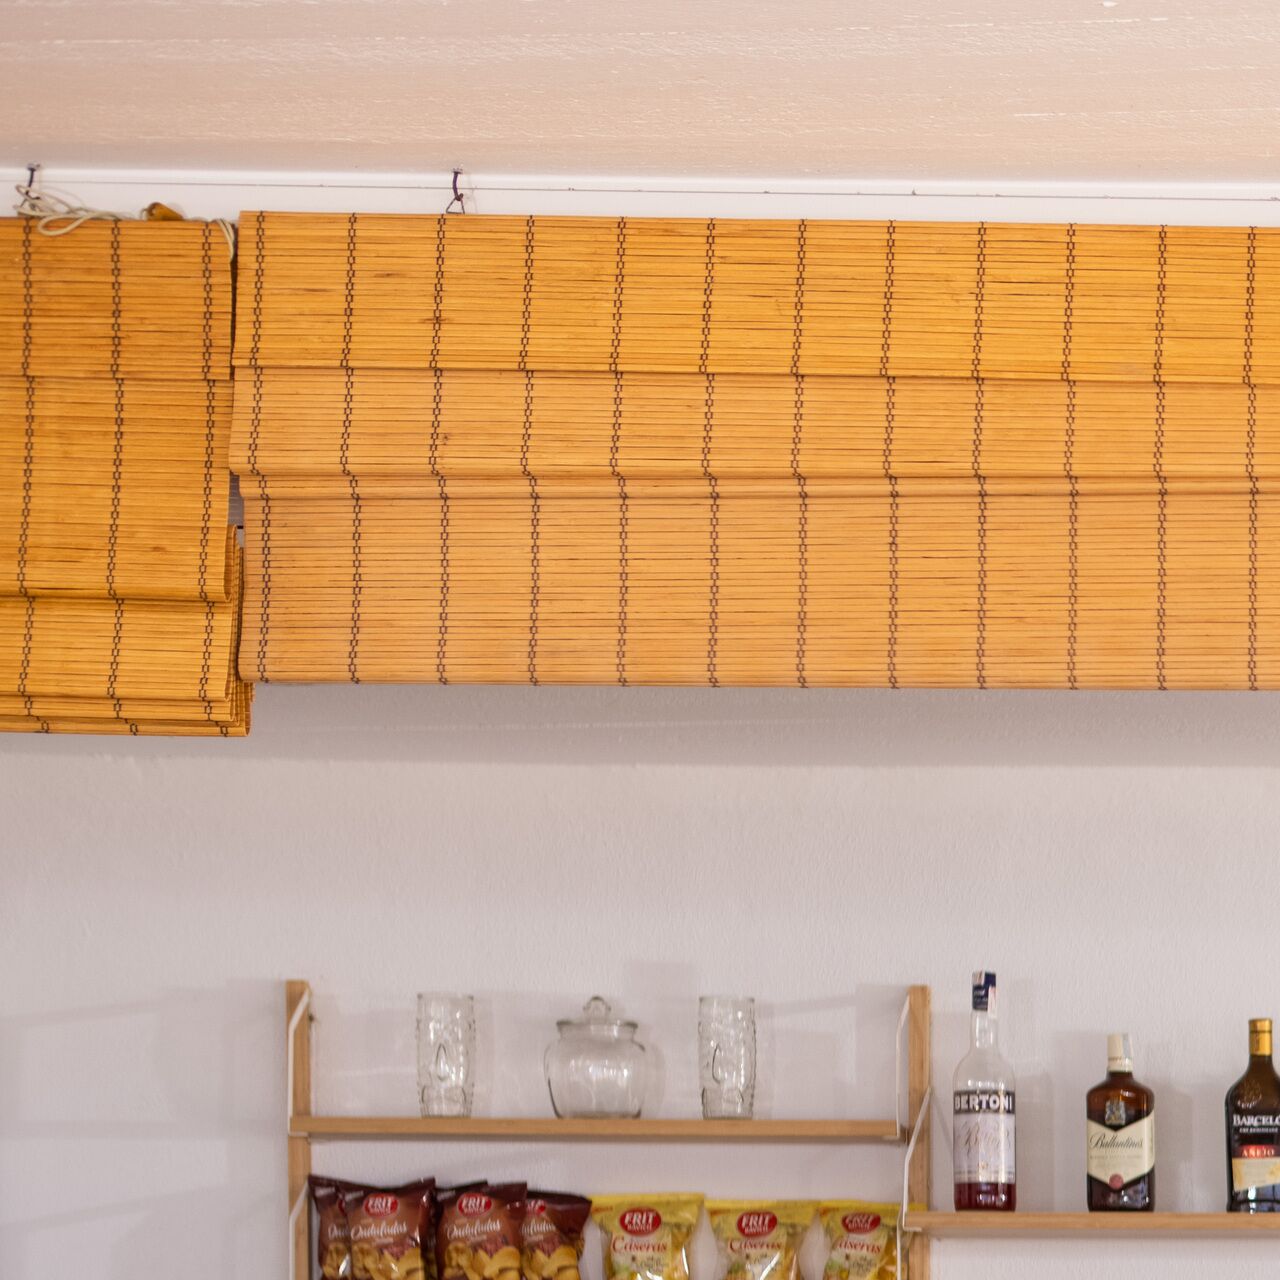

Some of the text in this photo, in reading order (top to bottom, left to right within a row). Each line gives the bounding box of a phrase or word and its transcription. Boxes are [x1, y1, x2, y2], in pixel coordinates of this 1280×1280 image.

[954, 1093, 1013, 1112] BERTONI
[367, 1196, 393, 1209] FRIT
[461, 1195, 487, 1209] FRIT
[624, 1211, 656, 1226] FRIT
[741, 1214, 771, 1228] FRIT
